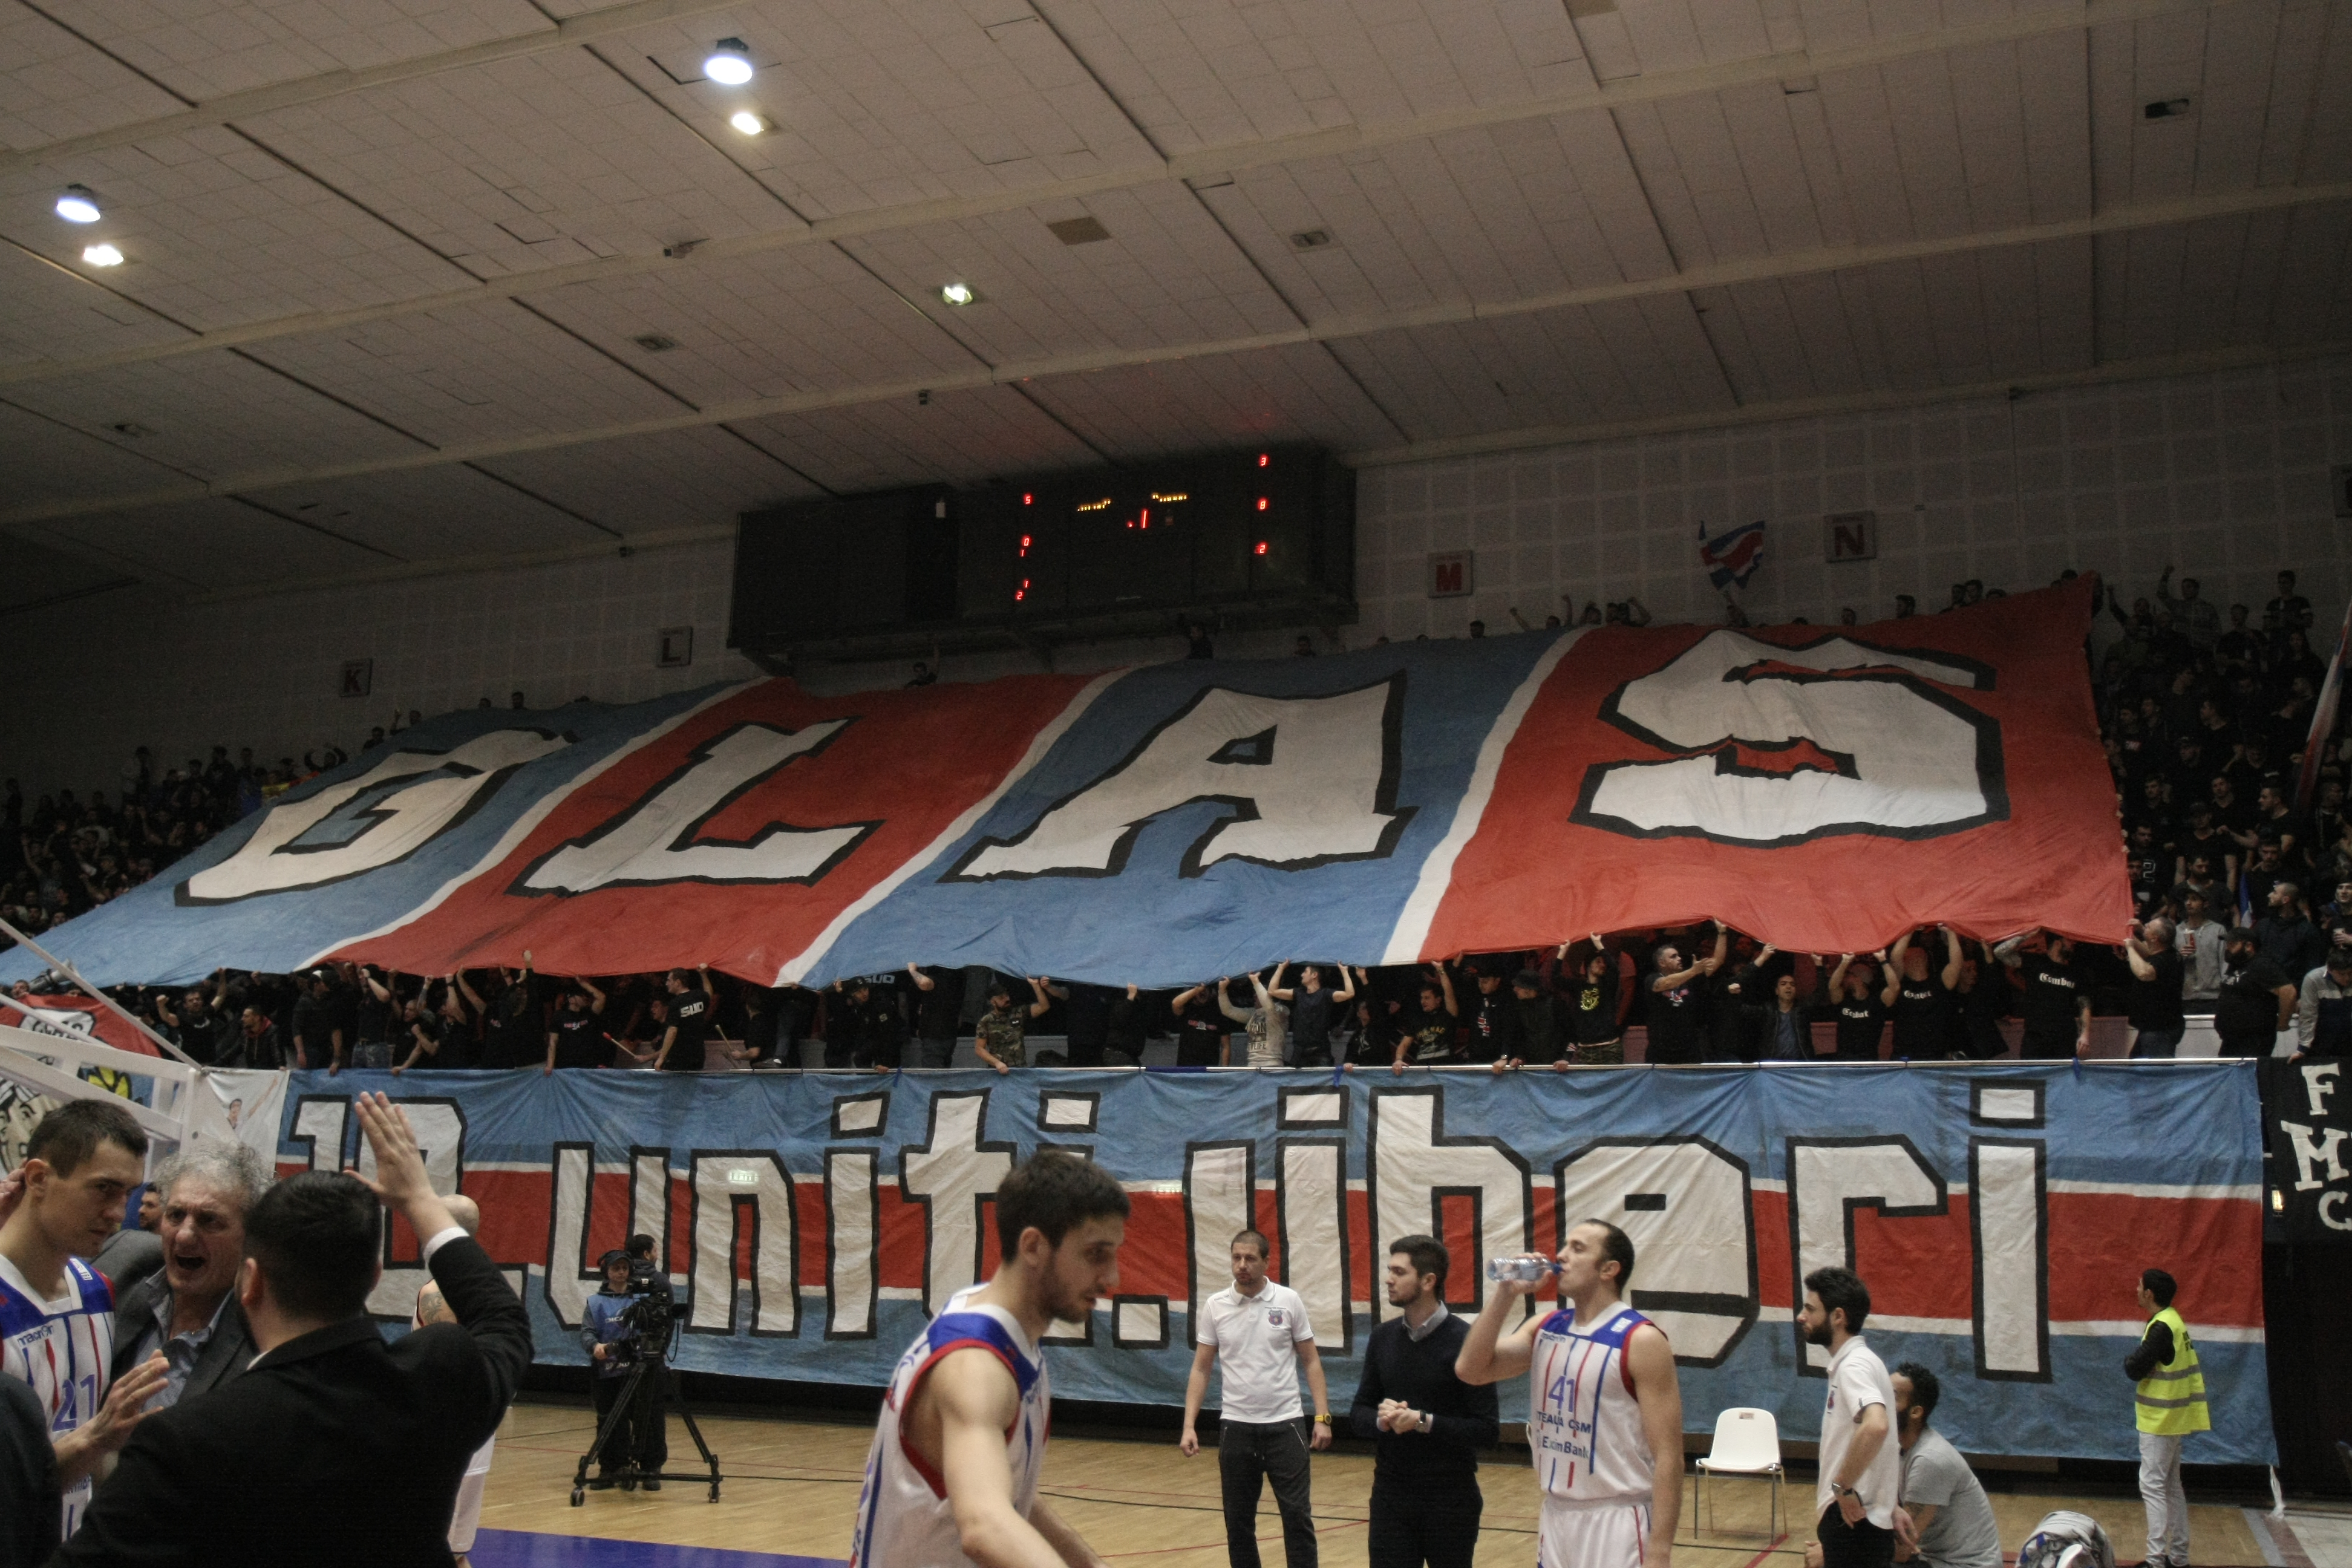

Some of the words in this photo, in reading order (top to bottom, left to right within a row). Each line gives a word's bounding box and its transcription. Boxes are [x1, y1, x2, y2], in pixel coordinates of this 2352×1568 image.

[1835, 524, 1864, 556] N
[1436, 563, 1462, 592] M
[662, 637, 681, 662] L
[345, 668, 361, 693] K
[174, 627, 2011, 907] GLAS
[680, 1001, 704, 1018] SUD
[2301, 1062, 2341, 1116] F
[52, 1374, 95, 1433] 21
[1548, 1376, 1575, 1413] 41
[1568, 1419, 1592, 1433] CSM
